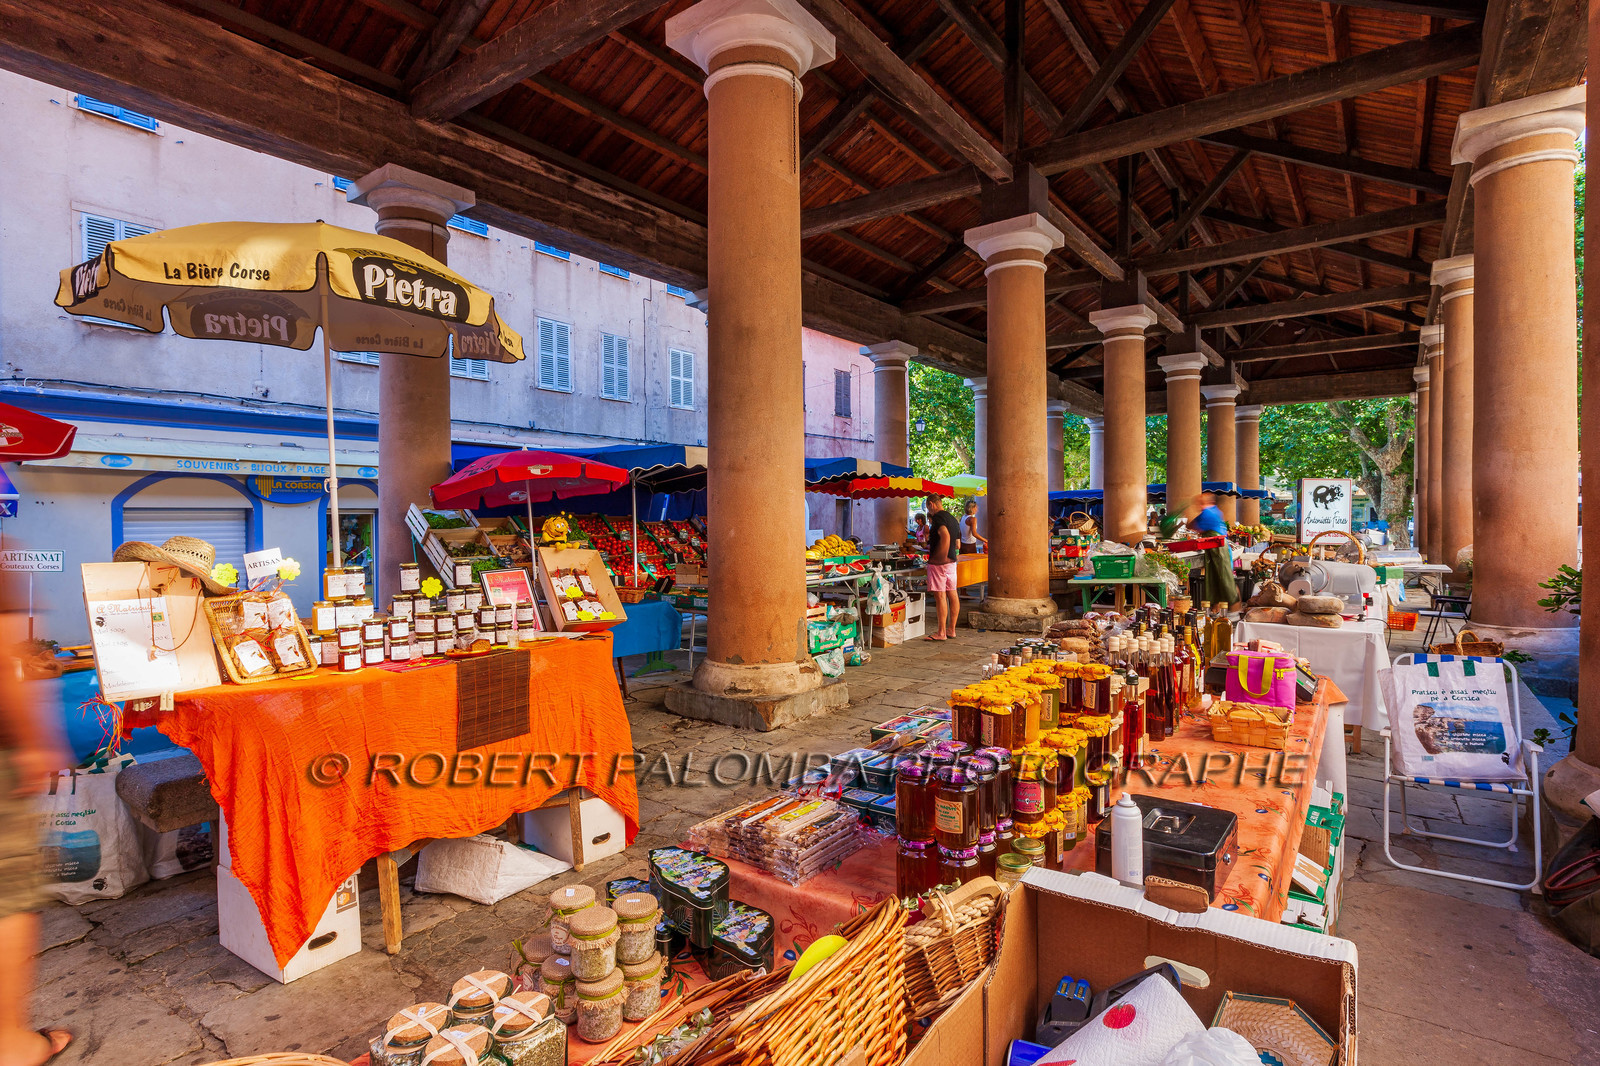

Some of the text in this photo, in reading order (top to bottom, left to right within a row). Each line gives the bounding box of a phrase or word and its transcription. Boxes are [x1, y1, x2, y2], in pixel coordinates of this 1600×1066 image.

[163, 262, 270, 281] La Bière Corse
[363, 264, 458, 317] Pietra
[176, 459, 240, 471] SOUVENIRS
[250, 463, 287, 473] BIJOUX
[296, 465, 326, 475] PLAGE
[3, 553, 61, 561] ARTISANAT
[1472, 688, 1497, 696] megliu
